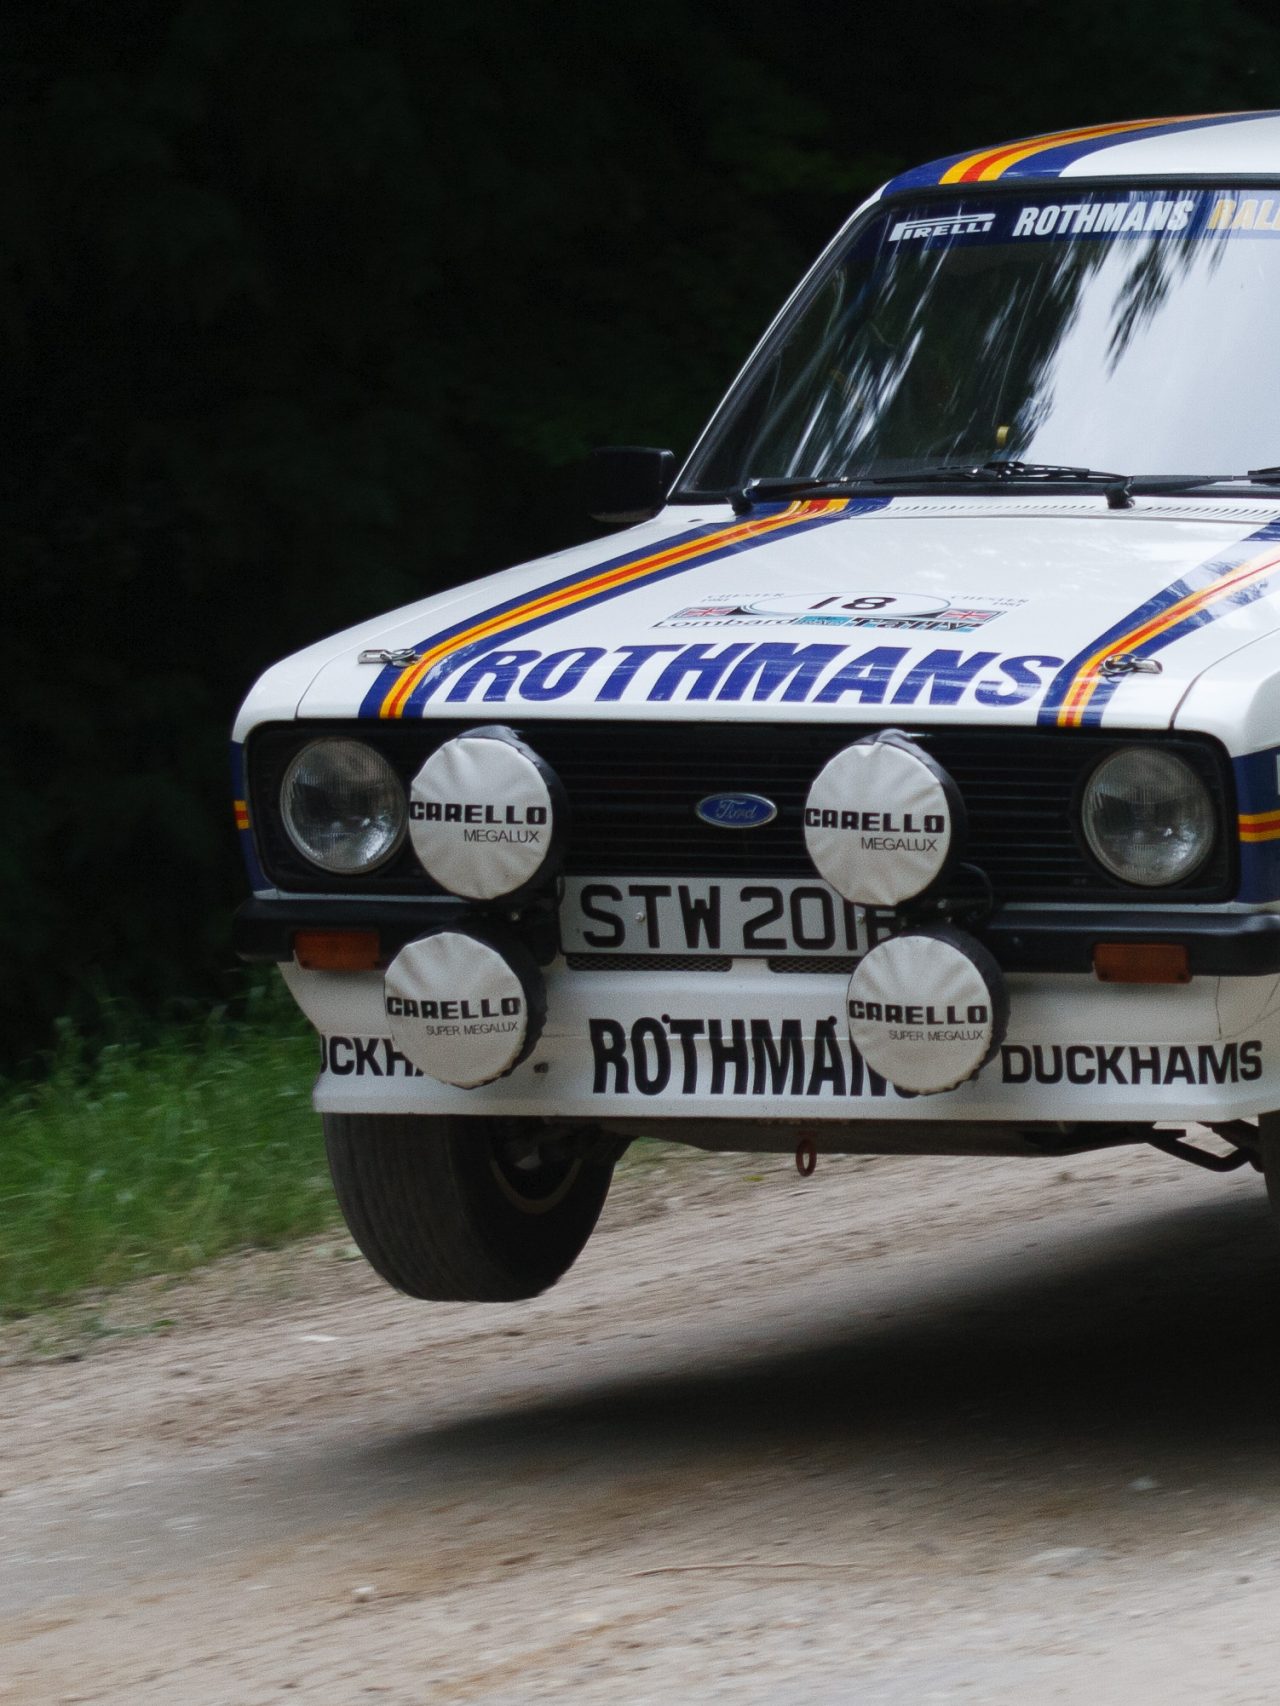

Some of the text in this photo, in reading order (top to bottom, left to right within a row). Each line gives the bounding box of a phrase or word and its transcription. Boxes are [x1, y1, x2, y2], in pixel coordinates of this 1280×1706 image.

[888, 213, 996, 242] PIRELLI
[1012, 200, 1194, 237] ROTHMANS
[807, 596, 898, 610] 18
[652, 617, 800, 628] Lombard
[445, 642, 1065, 706] ROTHMANS
[409, 801, 548, 825] CARELLO
[804, 807, 945, 834] CARELLO
[463, 829, 540, 844] MEGALUX
[860, 836, 938, 852] MEGALUX
[580, 884, 722, 950] STW
[386, 997, 521, 1020] CARELLO
[848, 1000, 988, 1026] CARELLO
[426, 1021, 519, 1037] SUPER MEGALUX
[888, 1028, 984, 1041] SUPER MEGALUX
[1002, 1039, 1264, 1086] DUCKHAMS
